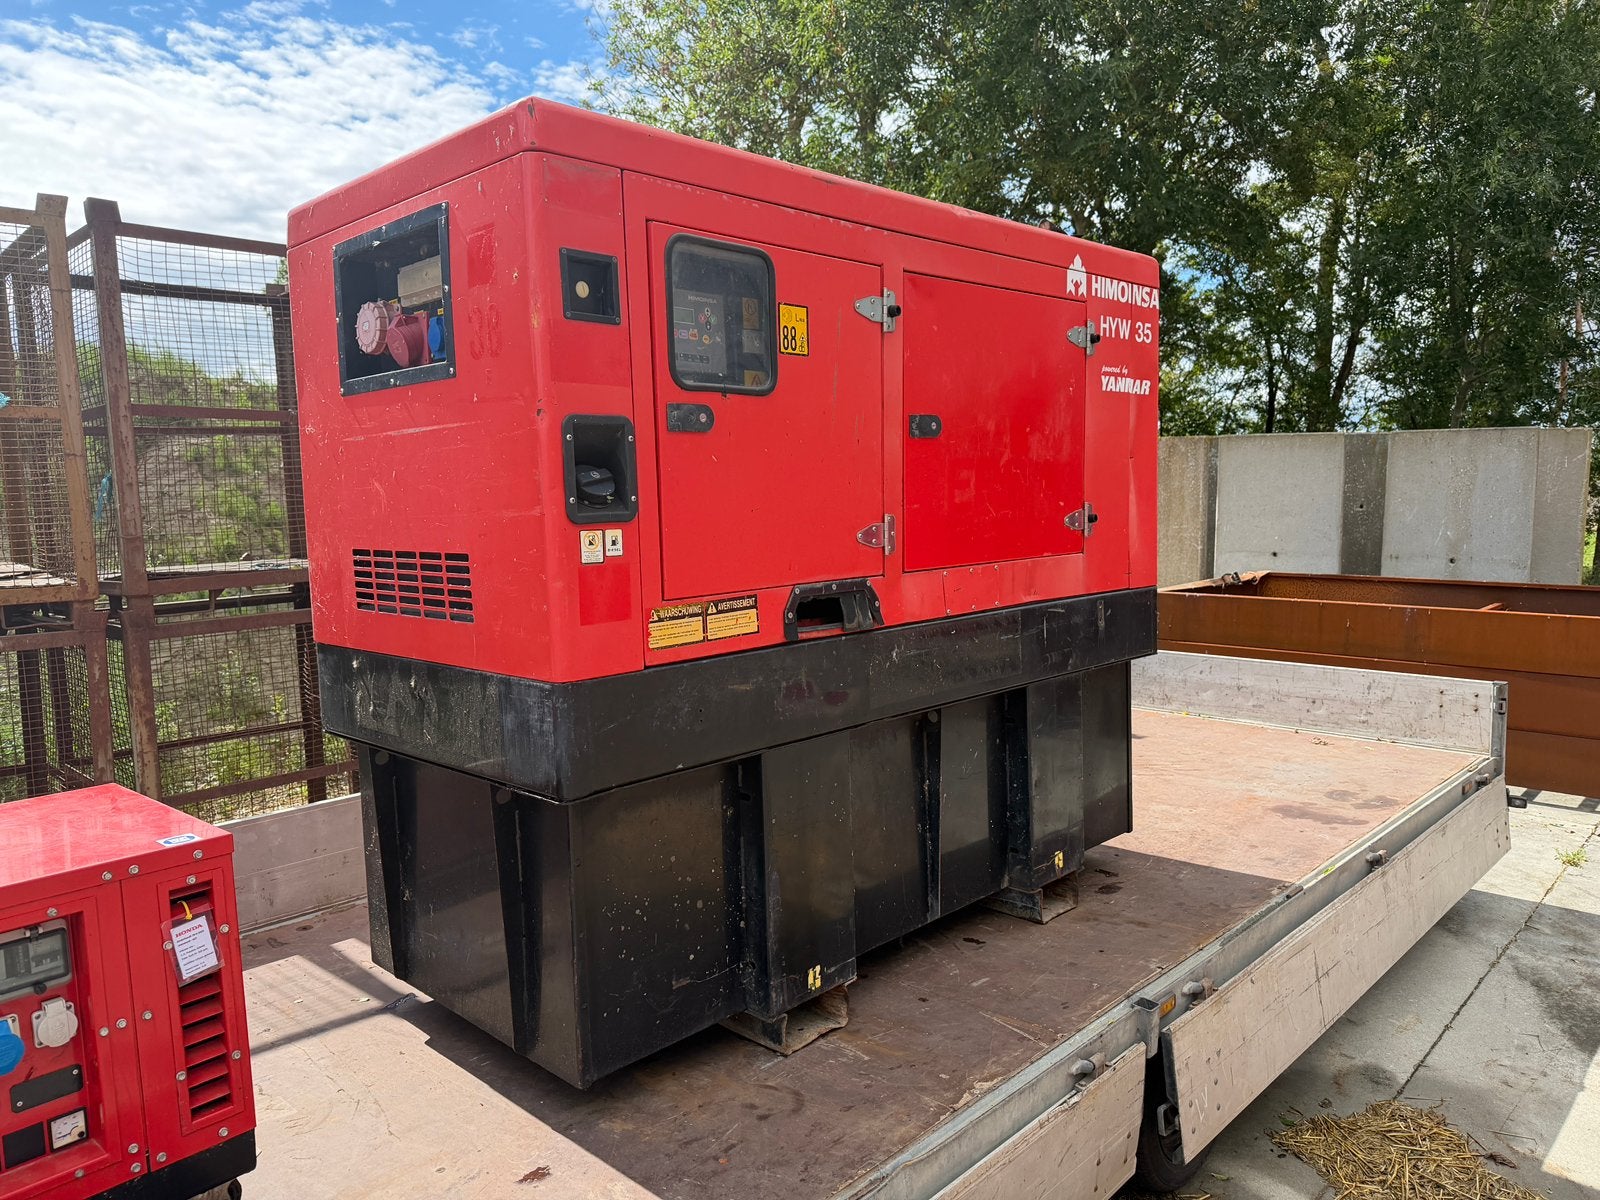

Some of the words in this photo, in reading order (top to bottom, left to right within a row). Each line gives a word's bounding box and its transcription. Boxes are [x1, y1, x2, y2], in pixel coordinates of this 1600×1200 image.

[1091, 275, 1160, 309] HIMOINSA
[782, 324, 798, 352] 88
[1100, 314, 1132, 341] HYW
[1134, 321, 1153, 344] 35
[1101, 365, 1121, 374] powered
[1121, 365, 1129, 376] by
[1100, 375, 1152, 396] YANMAR
[660, 605, 702, 619] WAARSCHUWING
[717, 597, 756, 611] AVERTISSEMENT
[175, 923, 203, 938] HONDA
